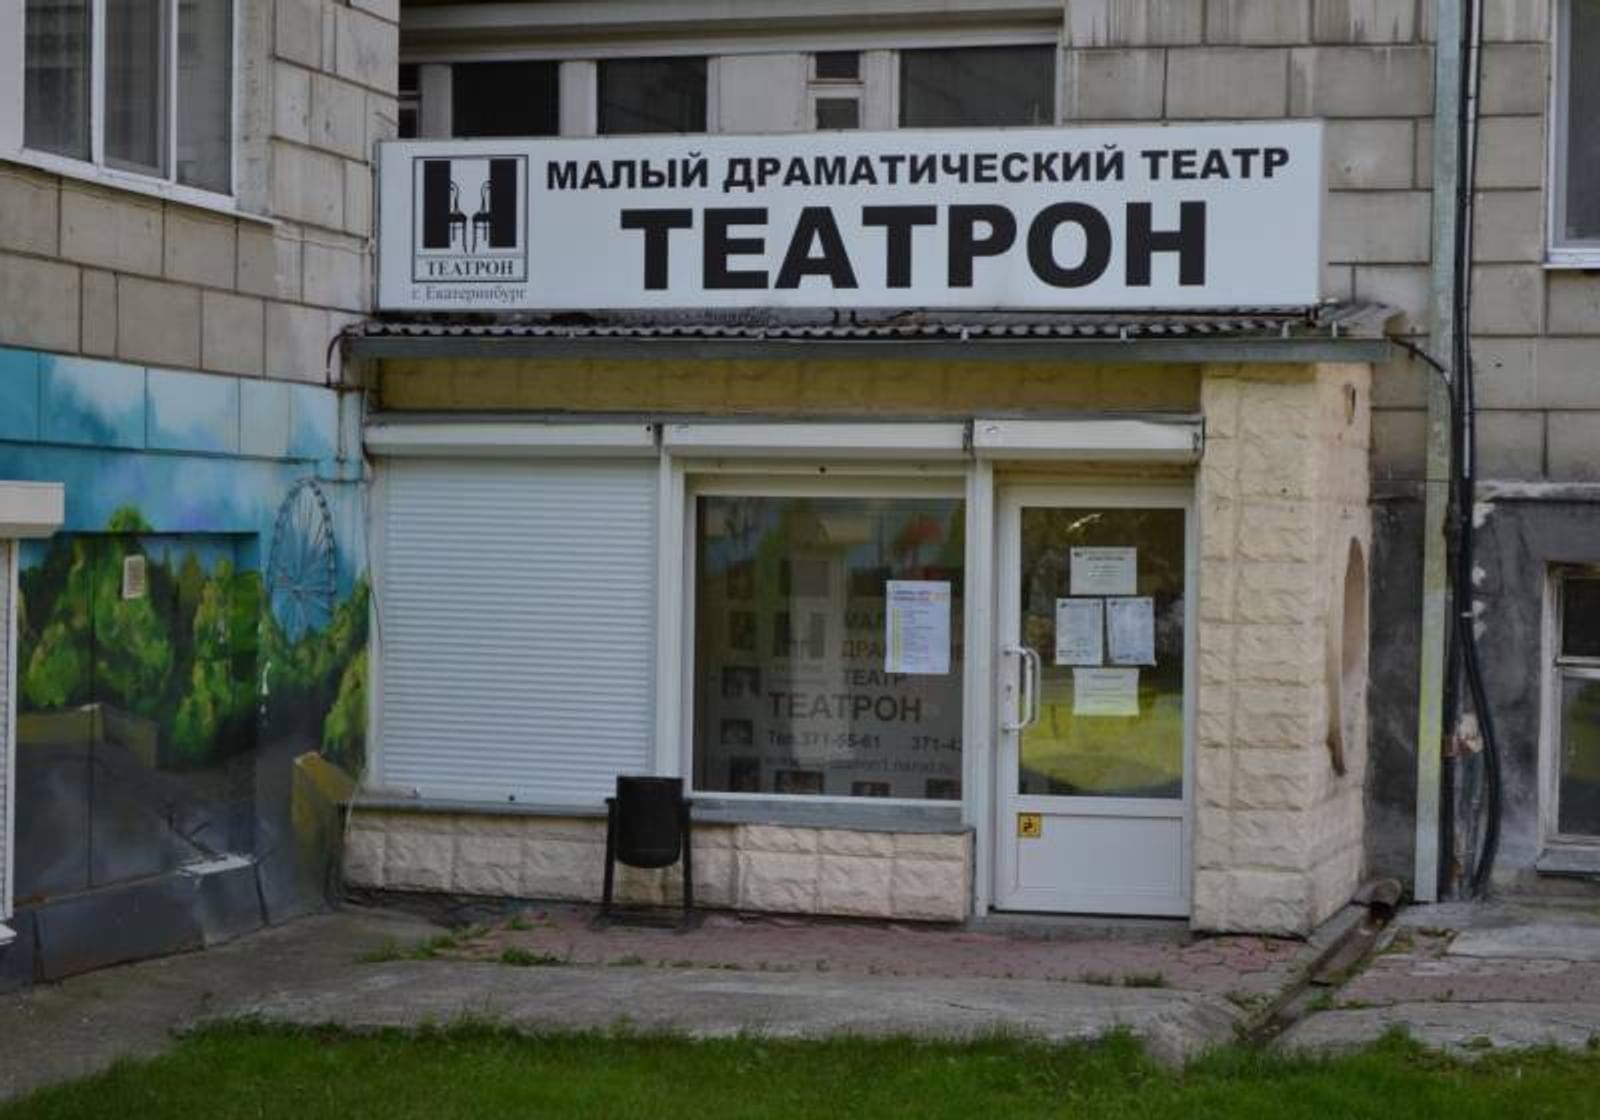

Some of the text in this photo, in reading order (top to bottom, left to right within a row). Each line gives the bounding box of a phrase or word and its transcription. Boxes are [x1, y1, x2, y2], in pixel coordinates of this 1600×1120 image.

[548, 144, 1290, 193] МАЛЫЙ ДРАМАТИЧЕСКИЙ ТЕАТР
[620, 200, 1207, 291] ТЕАТРОН
[427, 259, 514, 277] ТЕАТРОН
[426, 286, 527, 303] Екатеринбург
[768, 691, 922, 723] ТЕАТРОН
